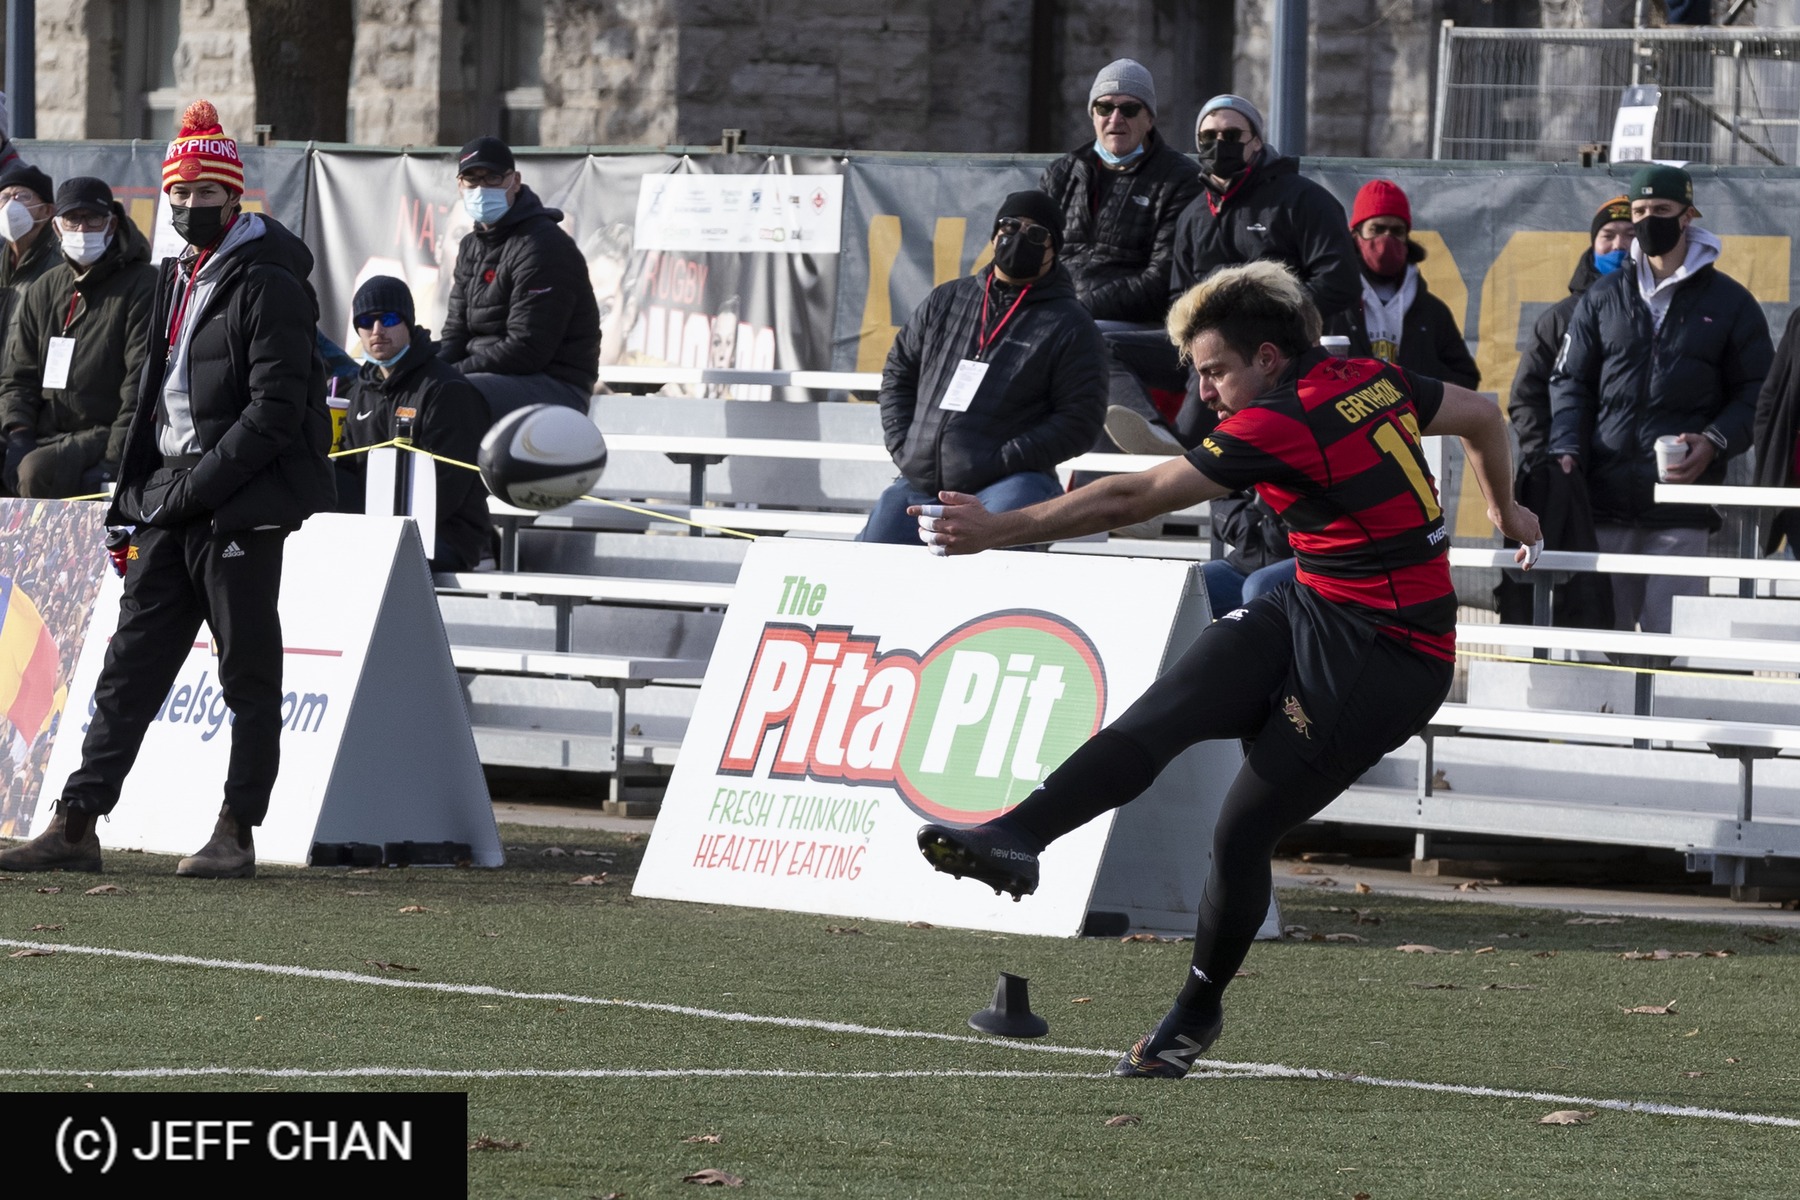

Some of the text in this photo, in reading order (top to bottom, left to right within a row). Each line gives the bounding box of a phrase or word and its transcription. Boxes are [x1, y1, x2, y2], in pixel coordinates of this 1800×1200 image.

[166, 139, 237, 160] RYPHONS
[642, 251, 708, 304] RUGBY
[776, 576, 827, 616] The
[727, 636, 1066, 781] Pita Pit
[708, 787, 880, 835] FRESH THINKING
[693, 834, 867, 881] HEALTHY EATING
